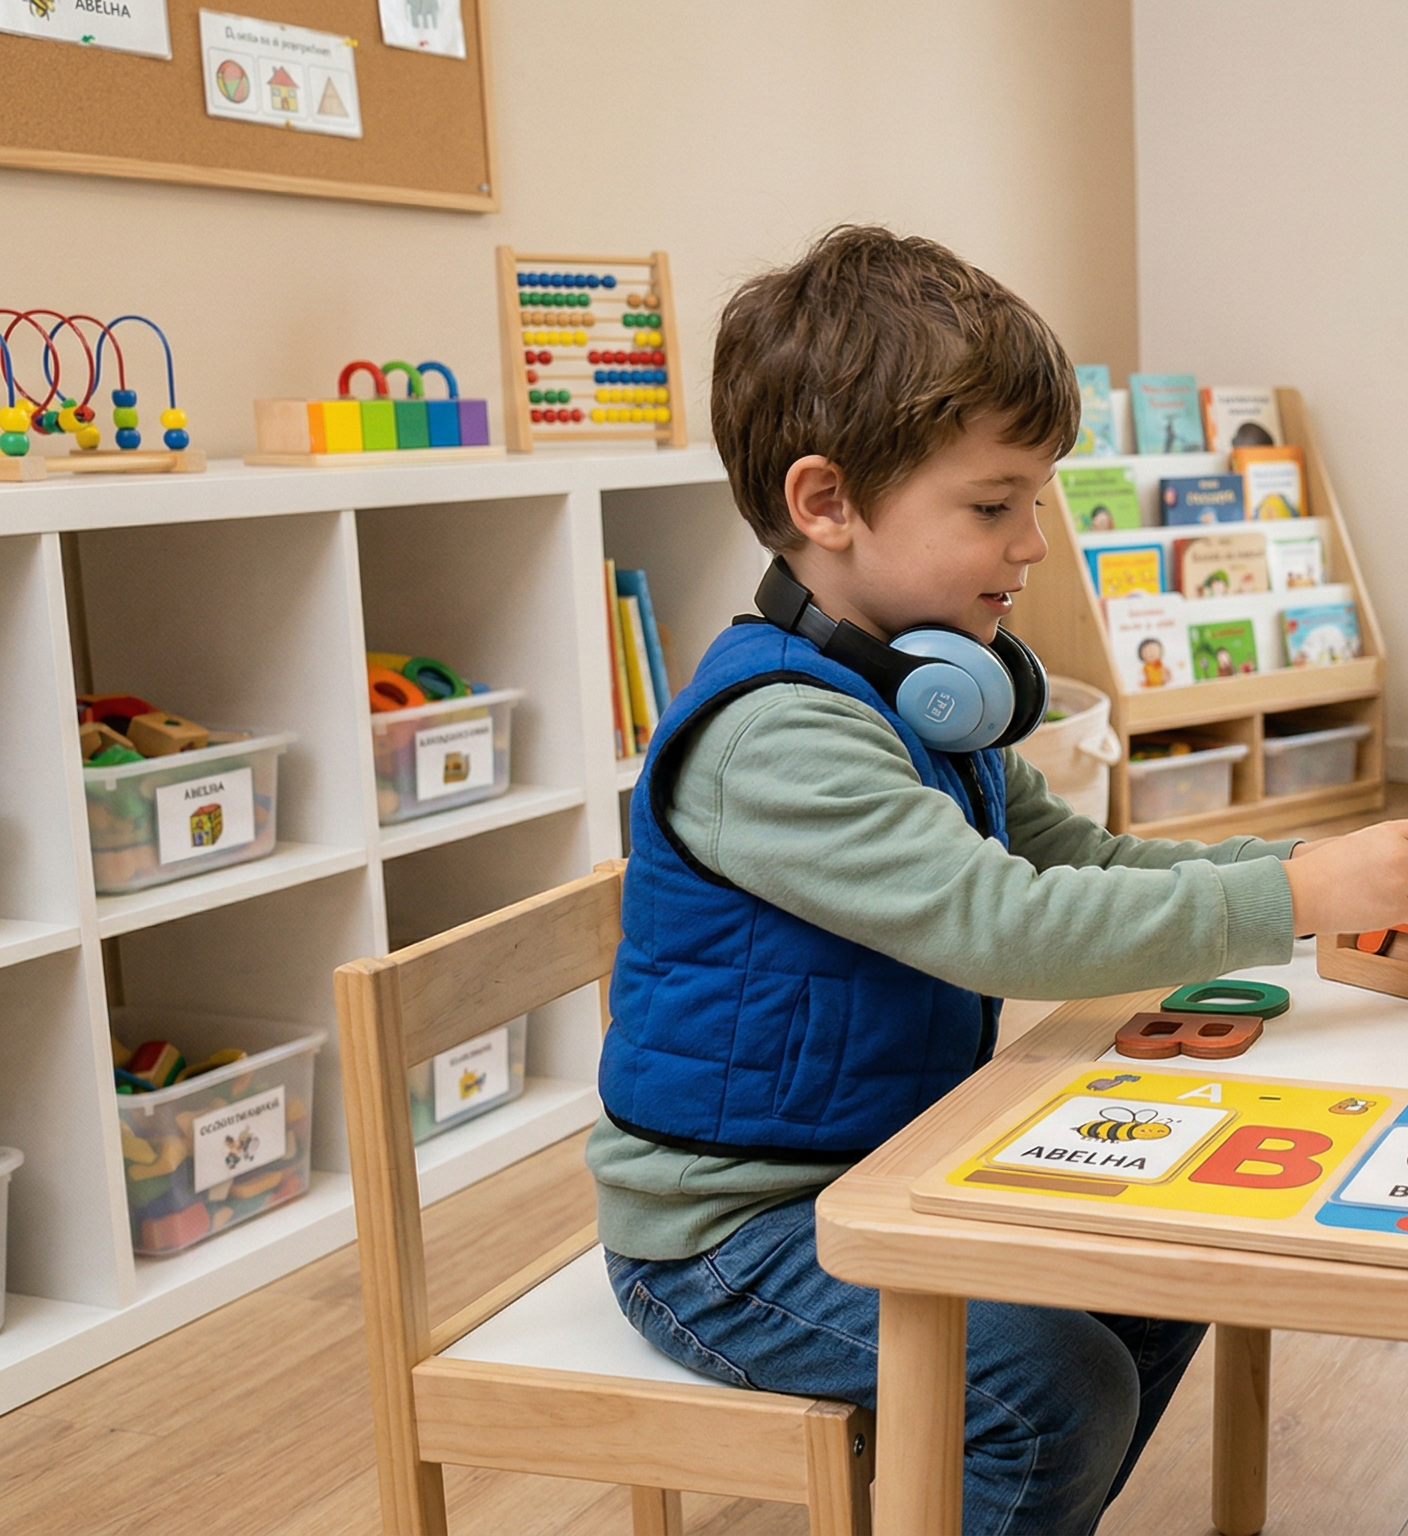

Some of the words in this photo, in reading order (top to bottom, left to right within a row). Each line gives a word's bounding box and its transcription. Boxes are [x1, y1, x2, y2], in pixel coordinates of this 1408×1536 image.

[75, 0, 131, 18] ABELHA
[1176, 1083, 1222, 1104] A
[1020, 1145, 1147, 1170] ABELHA
[1188, 1125, 1334, 1189] B
